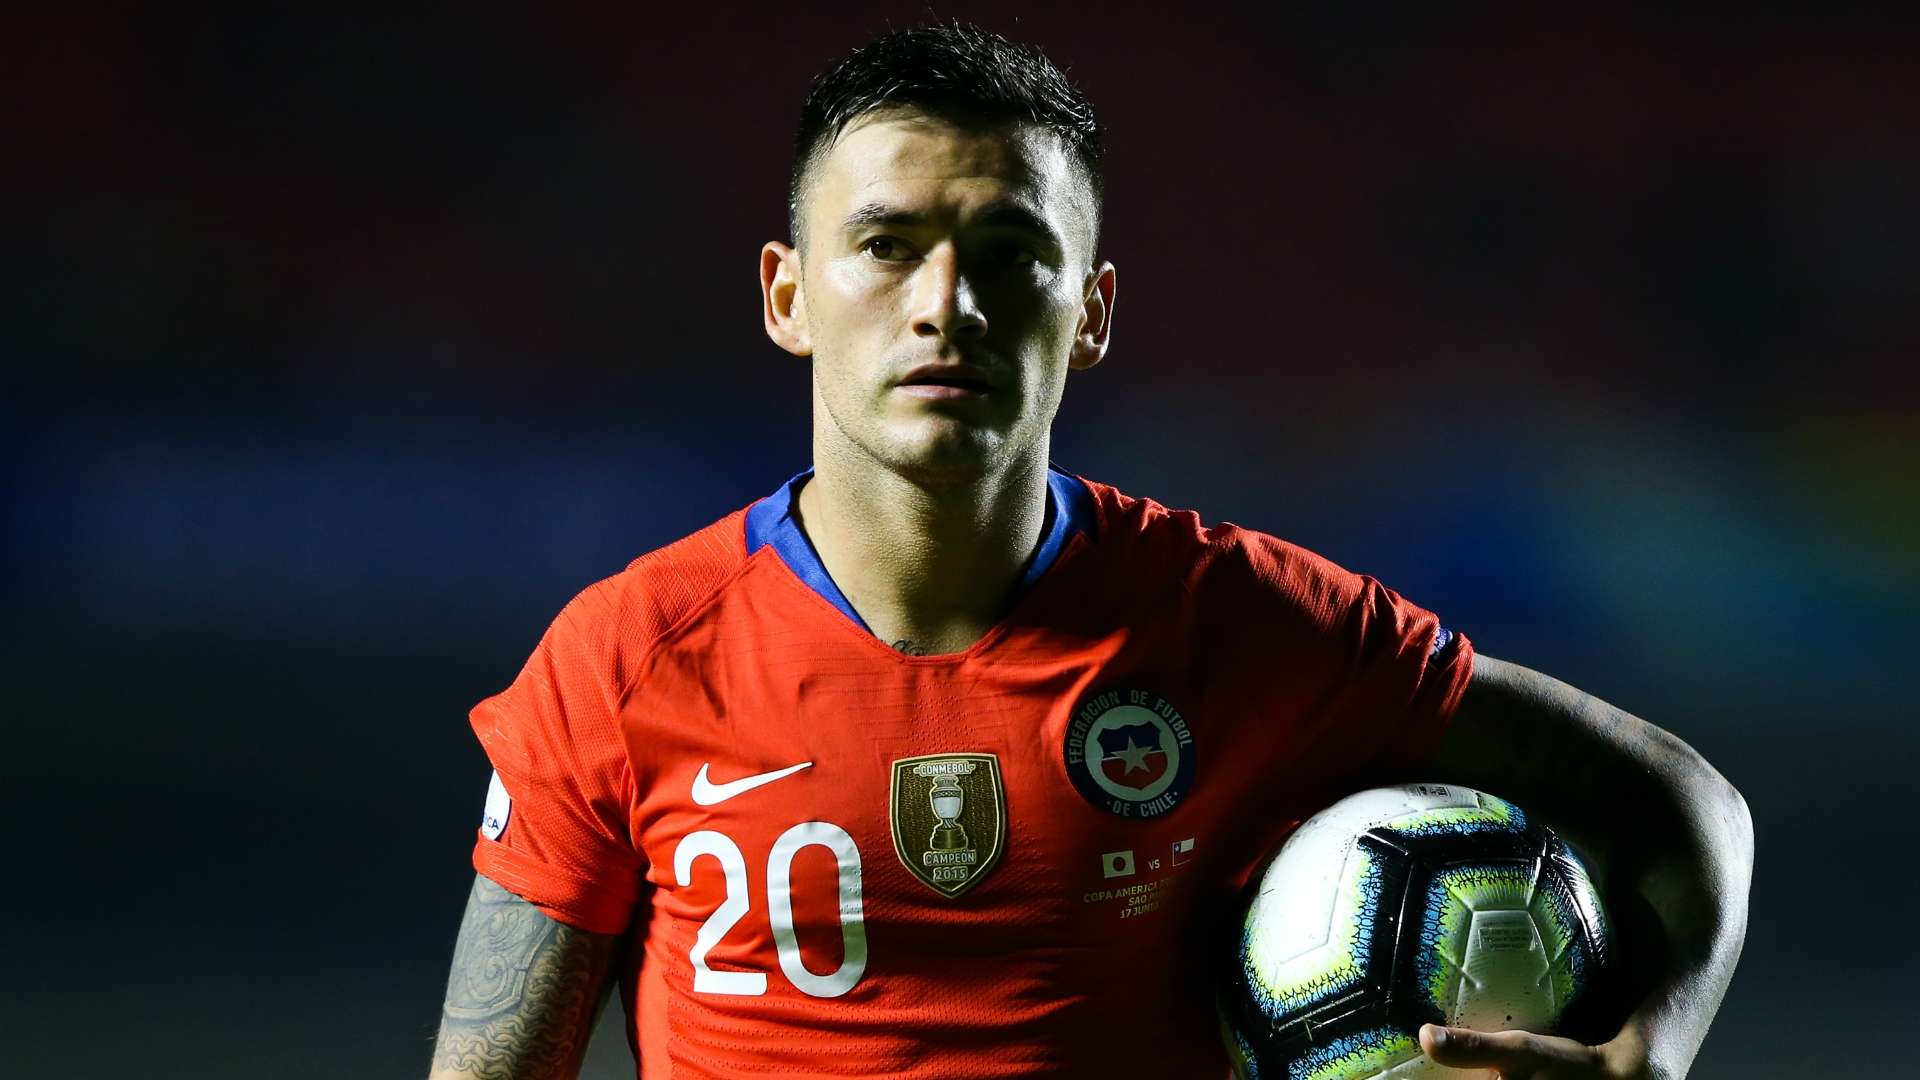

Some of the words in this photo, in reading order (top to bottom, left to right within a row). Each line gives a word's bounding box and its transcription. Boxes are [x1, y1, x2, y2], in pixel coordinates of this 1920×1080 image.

[1130, 689, 1149, 705] DE
[1153, 698, 1193, 748] FUTBOL
[920, 763, 969, 775] CONMEBOL
[1112, 801, 1130, 817] DE
[1139, 792, 1176, 817] CHILE
[1148, 859, 1160, 870] VS
[935, 868, 966, 880] 2015
[1083, 891, 1113, 904] COPA
[674, 822, 868, 998] 20
[1120, 907, 1132, 919] 17
